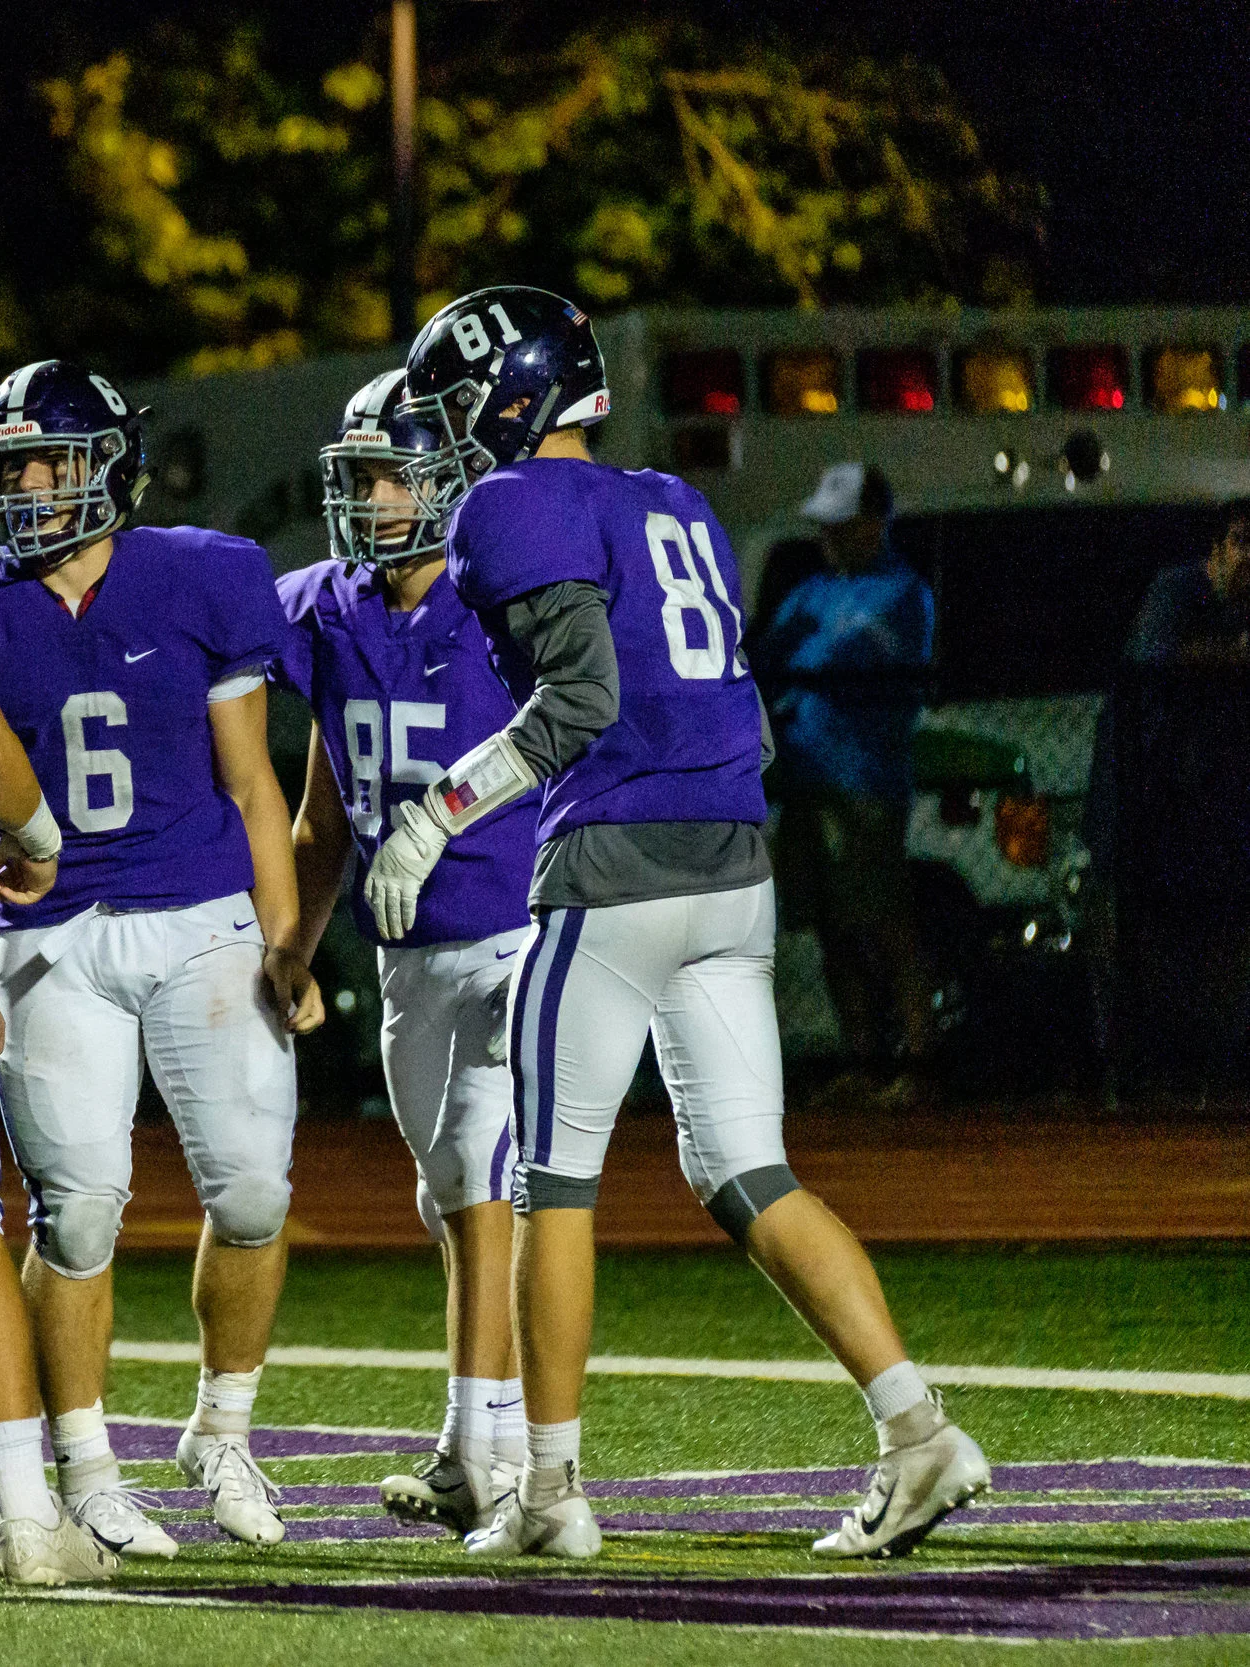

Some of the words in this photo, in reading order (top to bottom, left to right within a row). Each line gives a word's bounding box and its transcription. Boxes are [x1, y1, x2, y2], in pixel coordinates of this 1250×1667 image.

[452, 303, 522, 361] 81
[89, 375, 127, 416] 6
[346, 434, 383, 442] Riddell
[645, 511, 748, 679] 81
[60, 690, 134, 833] 6
[343, 699, 446, 837] 85
